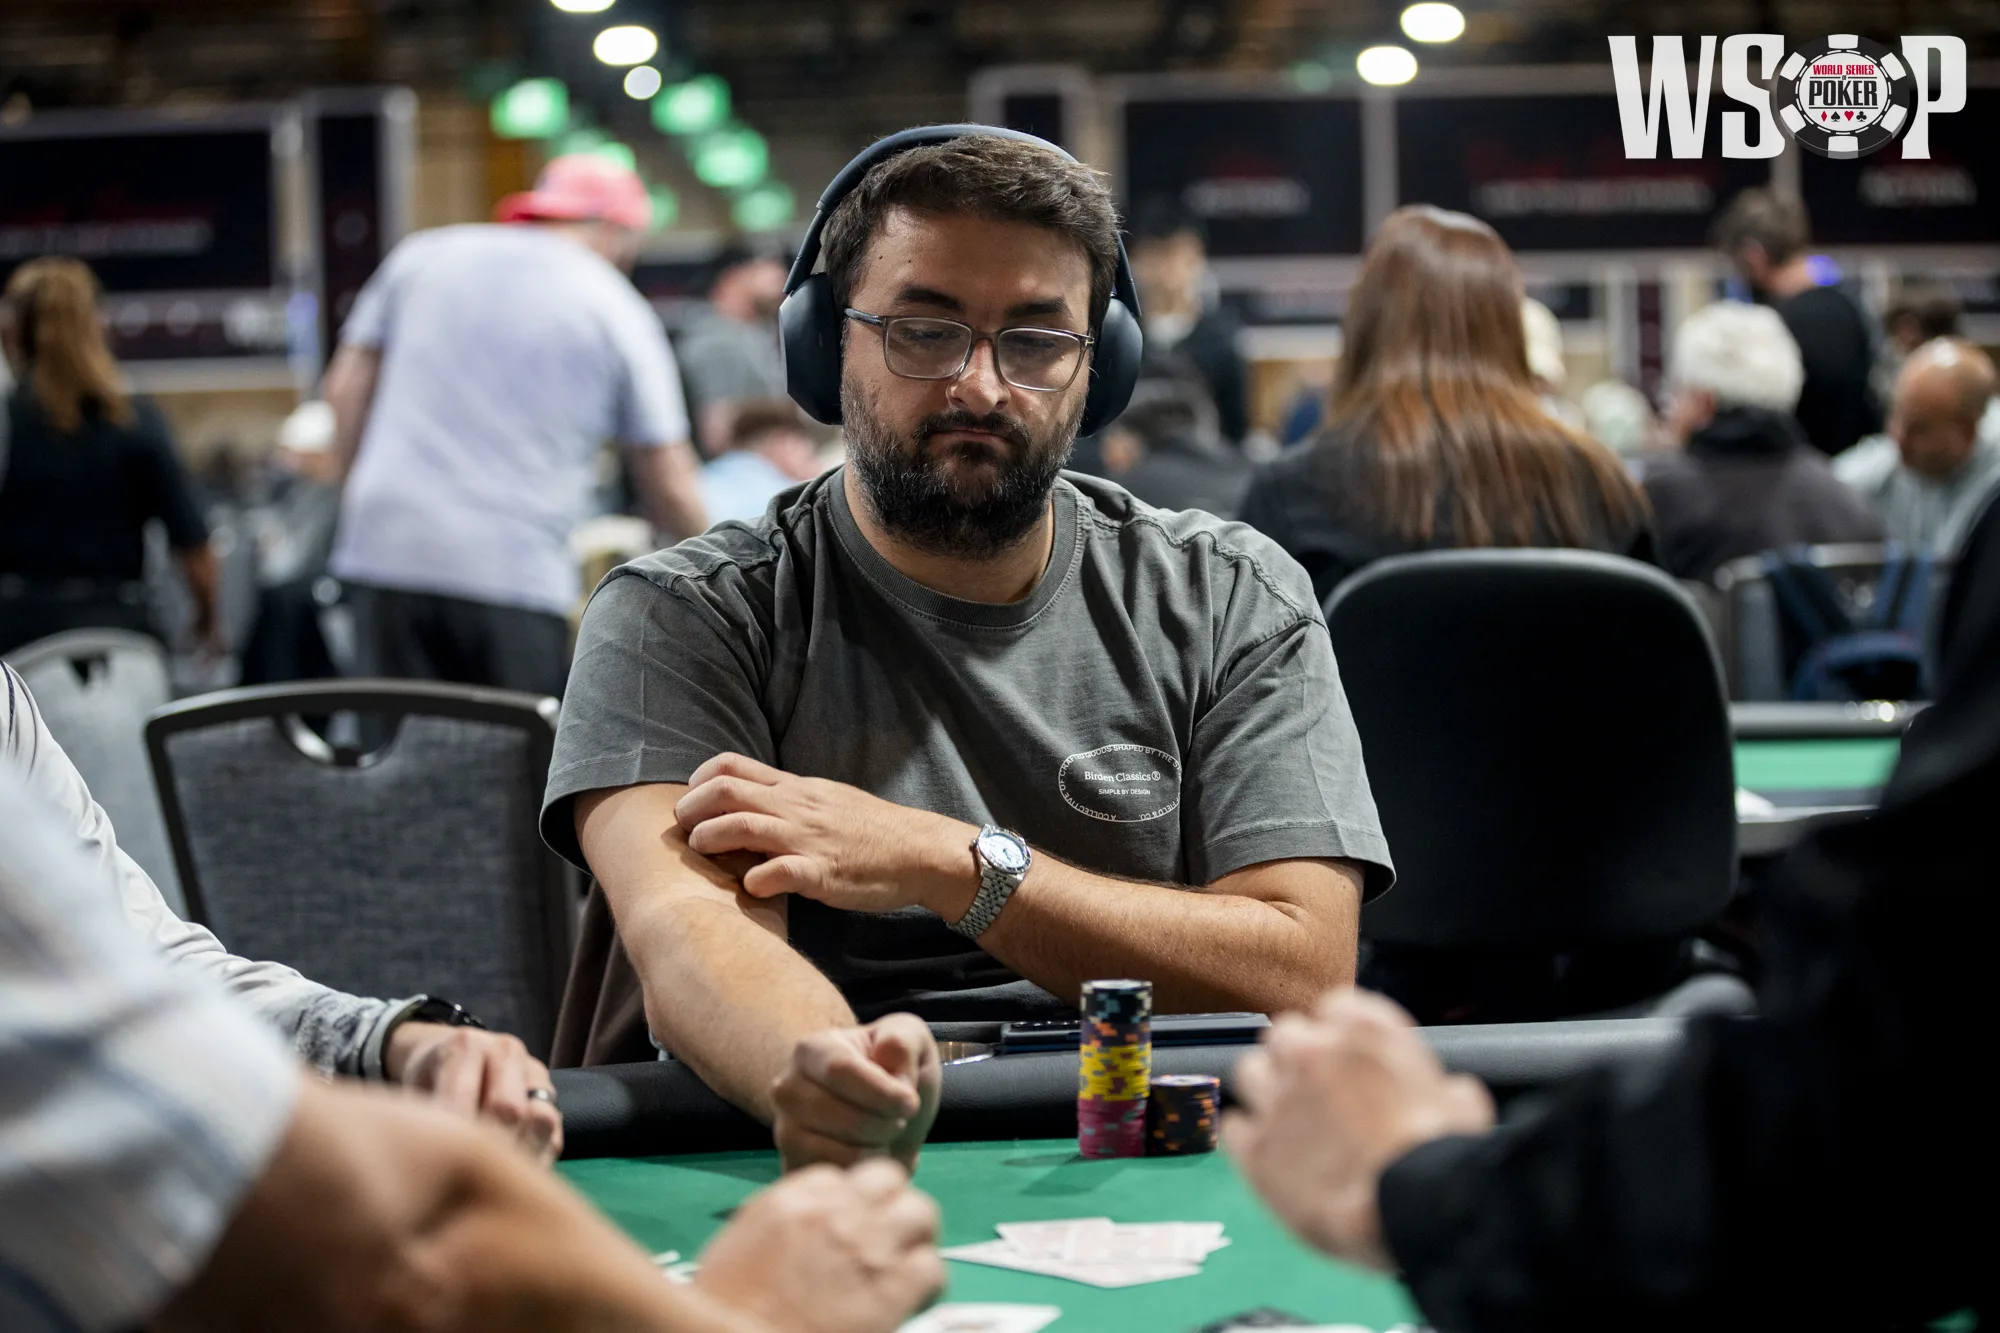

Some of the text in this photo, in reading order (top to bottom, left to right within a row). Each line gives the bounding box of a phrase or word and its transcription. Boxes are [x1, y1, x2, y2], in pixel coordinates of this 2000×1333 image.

[1085, 746, 1112, 759] GOODS
[1113, 745, 1143, 754] SHAPED
[1145, 747, 1156, 755] BY
[1157, 750, 1172, 764] THE
[1085, 771, 1114, 782] Birden
[1059, 779, 1067, 791] OF
[1064, 792, 1110, 820] COLLECTIVE
